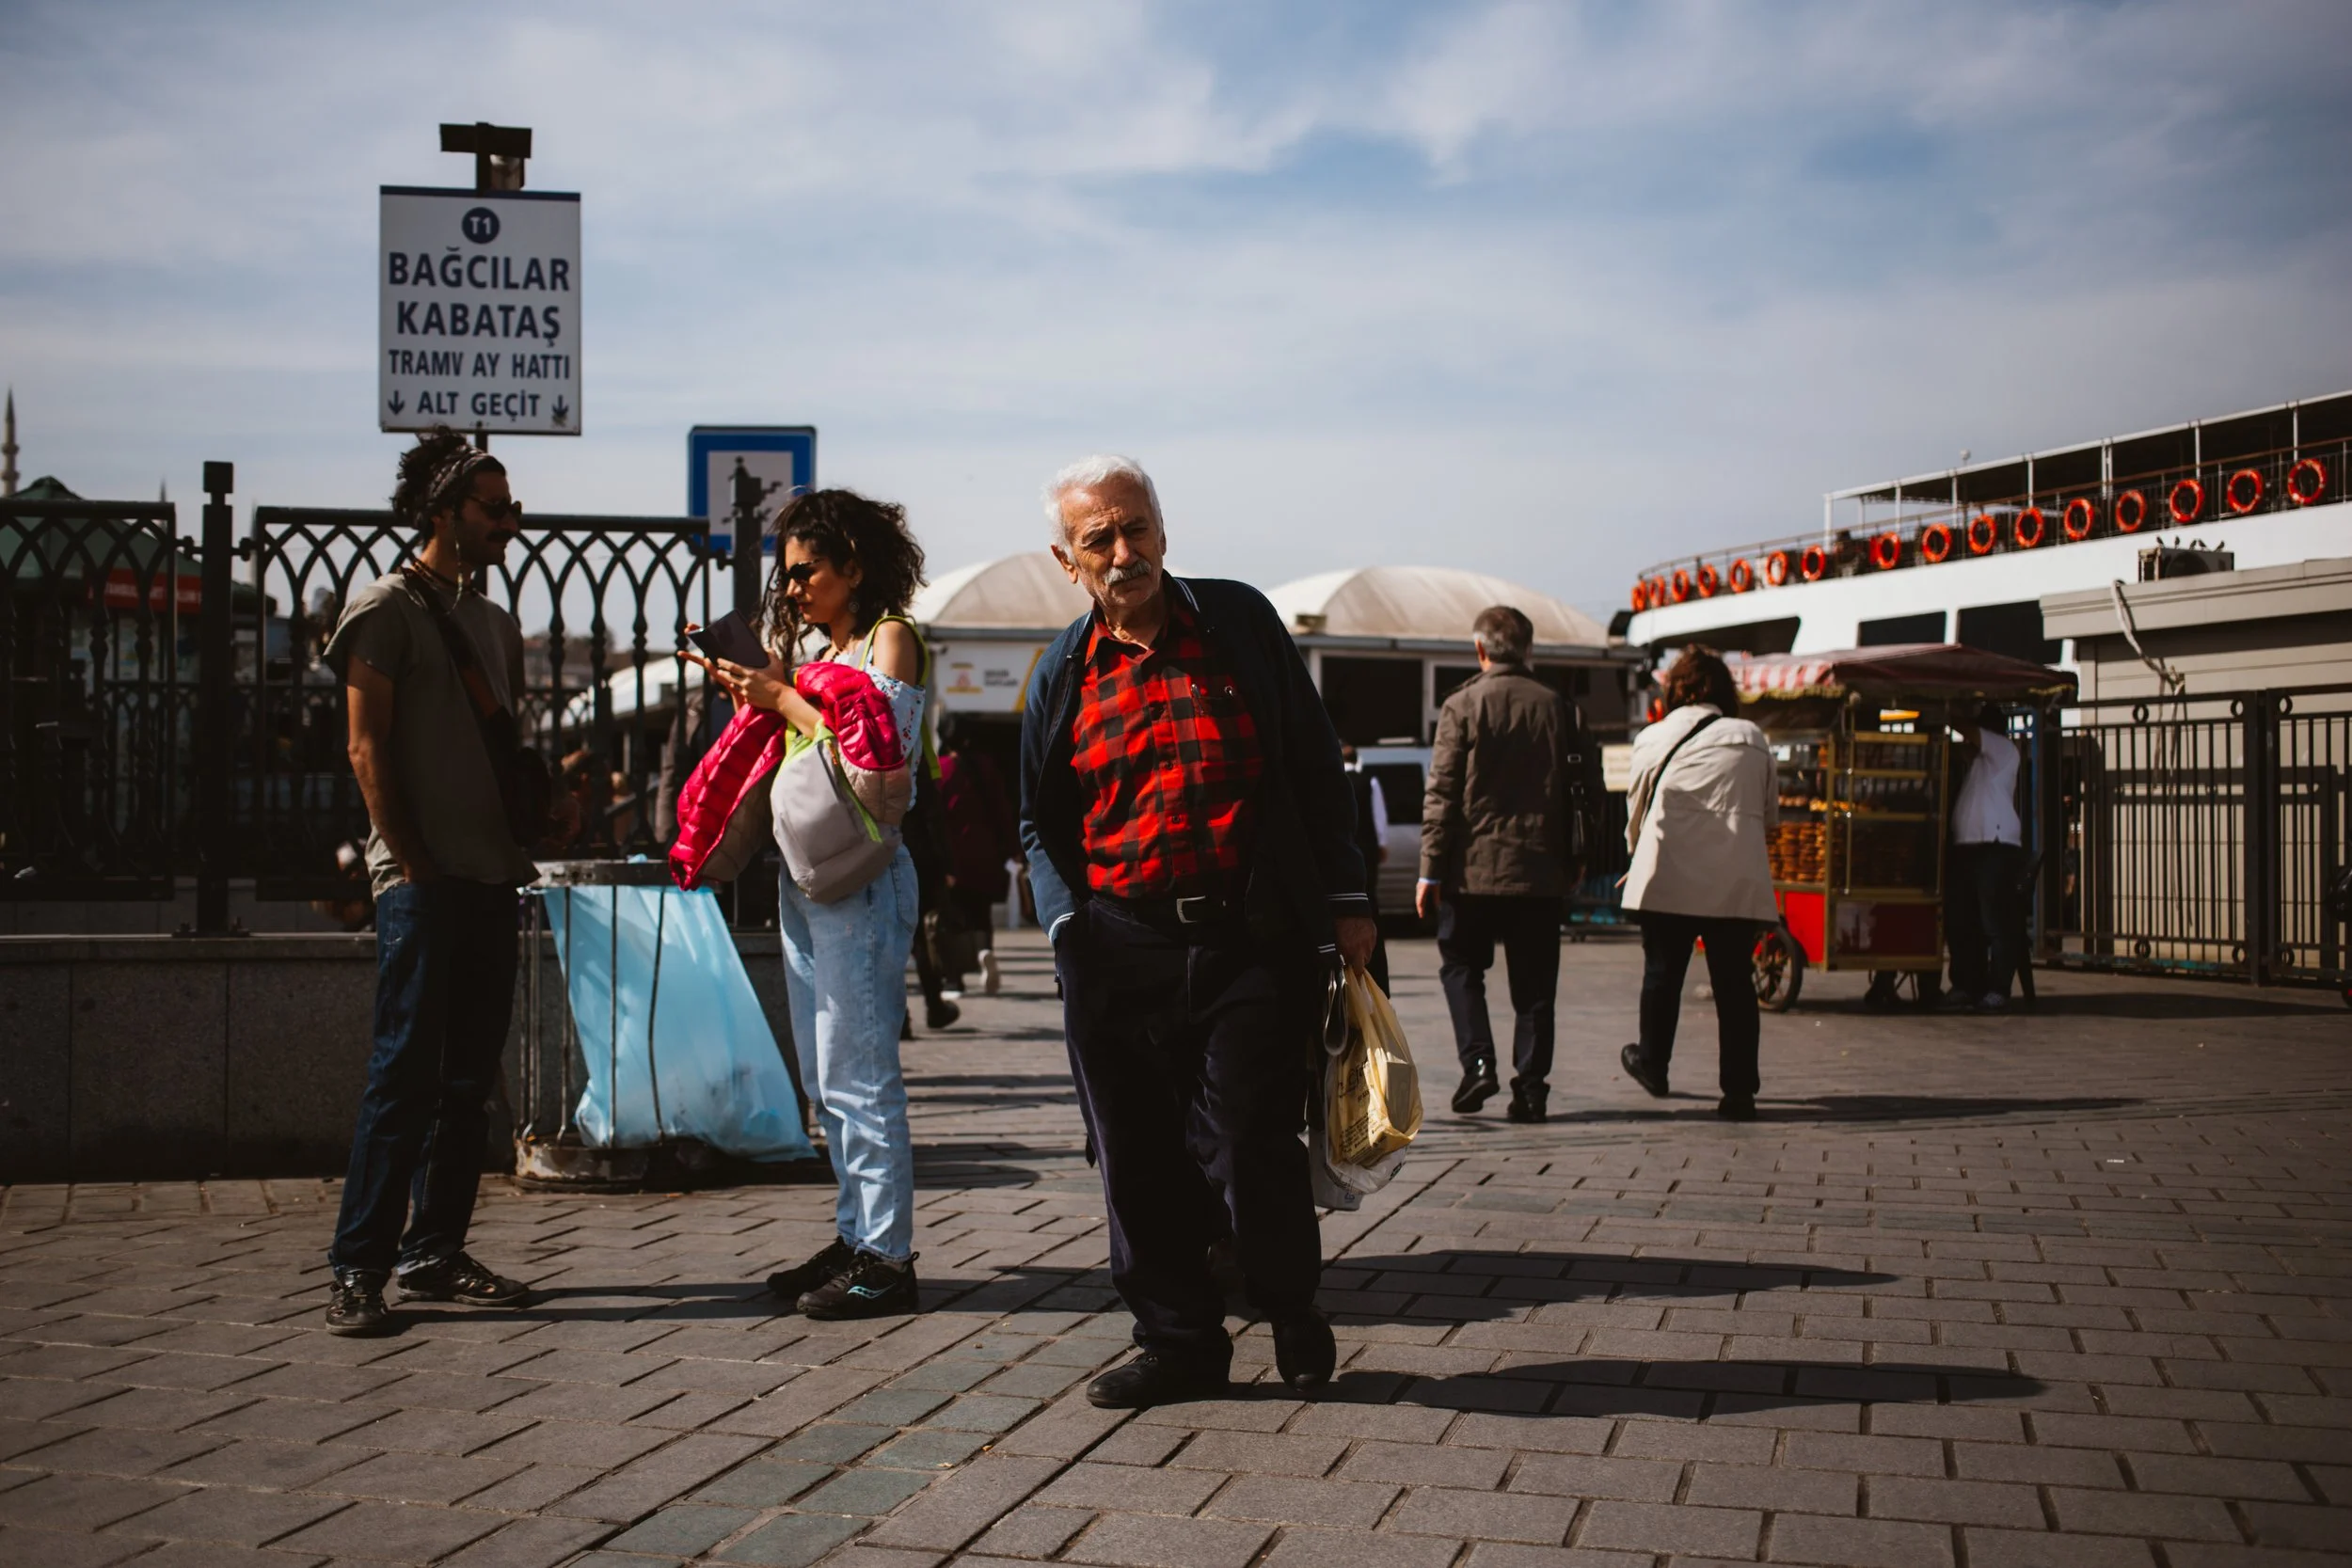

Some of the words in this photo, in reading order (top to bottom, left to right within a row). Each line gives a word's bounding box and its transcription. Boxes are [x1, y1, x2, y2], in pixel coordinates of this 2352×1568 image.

[470, 216, 491, 234] T1
[389, 245, 570, 292] BAĞCILAR
[397, 301, 560, 347] KABATAŞ
[512, 354, 570, 379] HATTI
[417, 391, 459, 415] ALT
[470, 389, 541, 421] GEÇİT
